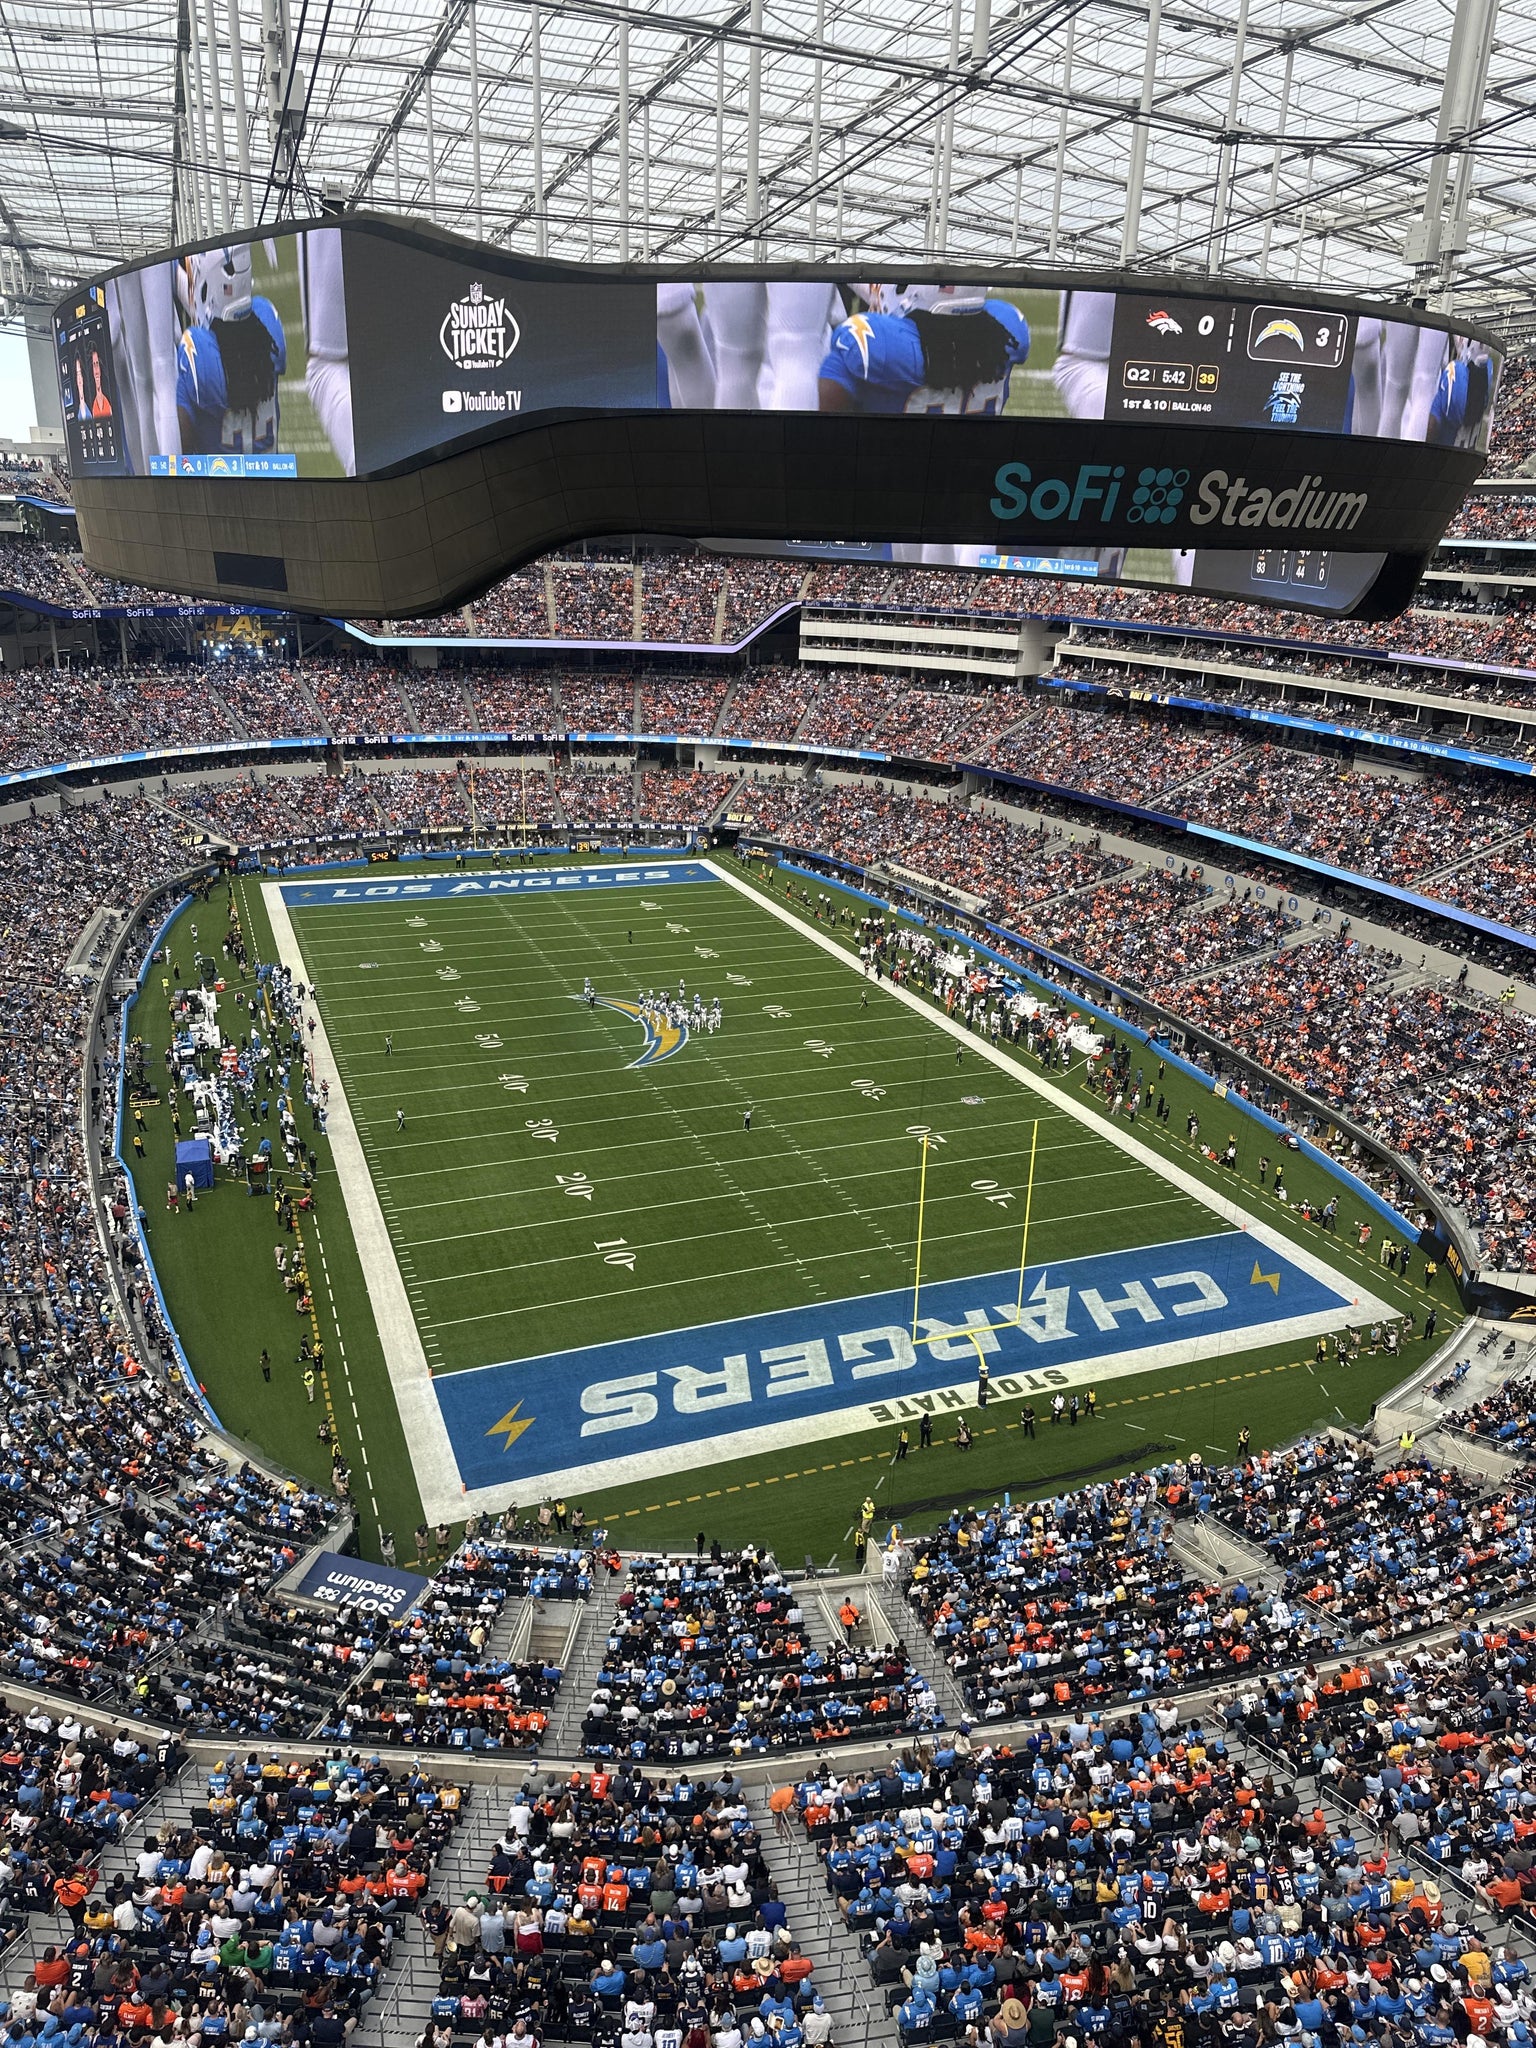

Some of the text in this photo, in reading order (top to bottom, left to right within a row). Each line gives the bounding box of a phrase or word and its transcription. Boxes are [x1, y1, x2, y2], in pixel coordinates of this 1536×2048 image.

[451, 298, 504, 329] SUNDAY
[1199, 315, 1215, 335] 0
[451, 327, 505, 360] TICKET
[1316, 328, 1330, 347] 3
[471, 360, 494, 368] YouTube TV
[1127, 368, 1185, 384] Q2 5:42
[1199, 373, 1215, 384] 39
[1279, 373, 1302, 383] SEE THE
[1272, 382, 1305, 393] LIGHTNING
[463, 390, 521, 411] YouTube TV
[1123, 399, 1141, 409] 1ST
[1142, 400, 1152, 410] &
[1154, 400, 1167, 410] 10
[1172, 402, 1190, 411] BALL
[1272, 404, 1285, 414] FEEL
[197, 461, 201, 470] 0
[232, 462, 237, 470] 3
[990, 462, 1368, 530] SoFi Stadium
[1256, 562, 1285, 576] 93 1
[1296, 566, 1324, 581] 44 0
[72, 610, 92, 618] SoFi
[126, 608, 145, 617] SoFi
[178, 607, 196, 616] SoFi
[215, 616, 250, 634] LA
[744, 814, 754, 822] UP
[193, 836, 204, 844] UP
[371, 852, 388, 861] 5:42
[332, 870, 670, 898] LOS ANGELES
[435, 966, 461, 980] 30
[728, 972, 754, 986] 40
[454, 996, 481, 1012] 40
[762, 1005, 792, 1018] 50
[474, 1033, 504, 1048] 50
[803, 1039, 835, 1055] 40
[498, 1073, 529, 1090] 40
[850, 1079, 887, 1098] 30
[525, 1118, 559, 1138] 30
[906, 1125, 948, 1148] 20
[555, 1172, 594, 1196] 20
[970, 1179, 1016, 1203] 10
[594, 1237, 636, 1265] 10
[580, 1270, 1230, 1438] CHARGERS
[868, 1370, 1069, 1422] STOP HATE
[886, 1558, 891, 1566] 3
[327, 1571, 406, 1603] Stadium
[340, 1592, 395, 1616] SoFi
[674, 1625, 686, 1634] 74
[1026, 1659, 1031, 1667] 1
[1359, 1675, 1370, 1686] 10
[530, 1722, 538, 1731] 10
[453, 1735, 463, 1745] 10
[158, 1750, 166, 1762] 8
[669, 1746, 678, 1755] 22
[594, 1782, 600, 1793] 2
[1038, 1778, 1049, 1790] 13
[634, 1786, 640, 1797] 7
[679, 1792, 688, 1801] 10
[445, 1795, 455, 1805] 10
[1507, 1798, 1517, 1810] 10
[60, 1807, 69, 1817] 11
[1470, 1805, 1481, 1817] 10
[624, 1834, 631, 1842] 11
[1010, 1828, 1020, 1840] 10
[923, 1839, 934, 1851] 10
[273, 1850, 282, 1861] 17
[1441, 1846, 1451, 1858] 10
[212, 1871, 223, 1882] 10
[920, 1866, 927, 1877] 7
[682, 1876, 689, 1888] 3
[1280, 1879, 1292, 1891] 18
[26, 1887, 38, 1897] 10
[393, 1888, 408, 1897] 18
[1255, 1884, 1268, 1899] 10
[608, 1897, 619, 1910] 14
[1056, 1897, 1068, 1908] 55
[1380, 1891, 1390, 1906] 10
[1143, 1904, 1156, 1919] 10
[1429, 1910, 1438, 1924] 7
[547, 1921, 558, 1932] 10
[752, 1944, 766, 1958] 10
[1270, 1946, 1283, 1963] 10
[276, 1957, 290, 1970] 55
[72, 1973, 82, 1986] 2
[1065, 1977, 1083, 1986] MANNING
[1064, 1987, 1083, 2001] 18
[102, 2012, 109, 2024] 2
[965, 2009, 979, 2020] 10
[915, 2018, 929, 2028] 10
[1091, 2023, 1104, 2032] 14
[1477, 2017, 1487, 2030] 2
[662, 2040, 676, 2048] 10
[1164, 2032, 1184, 2048] 50
